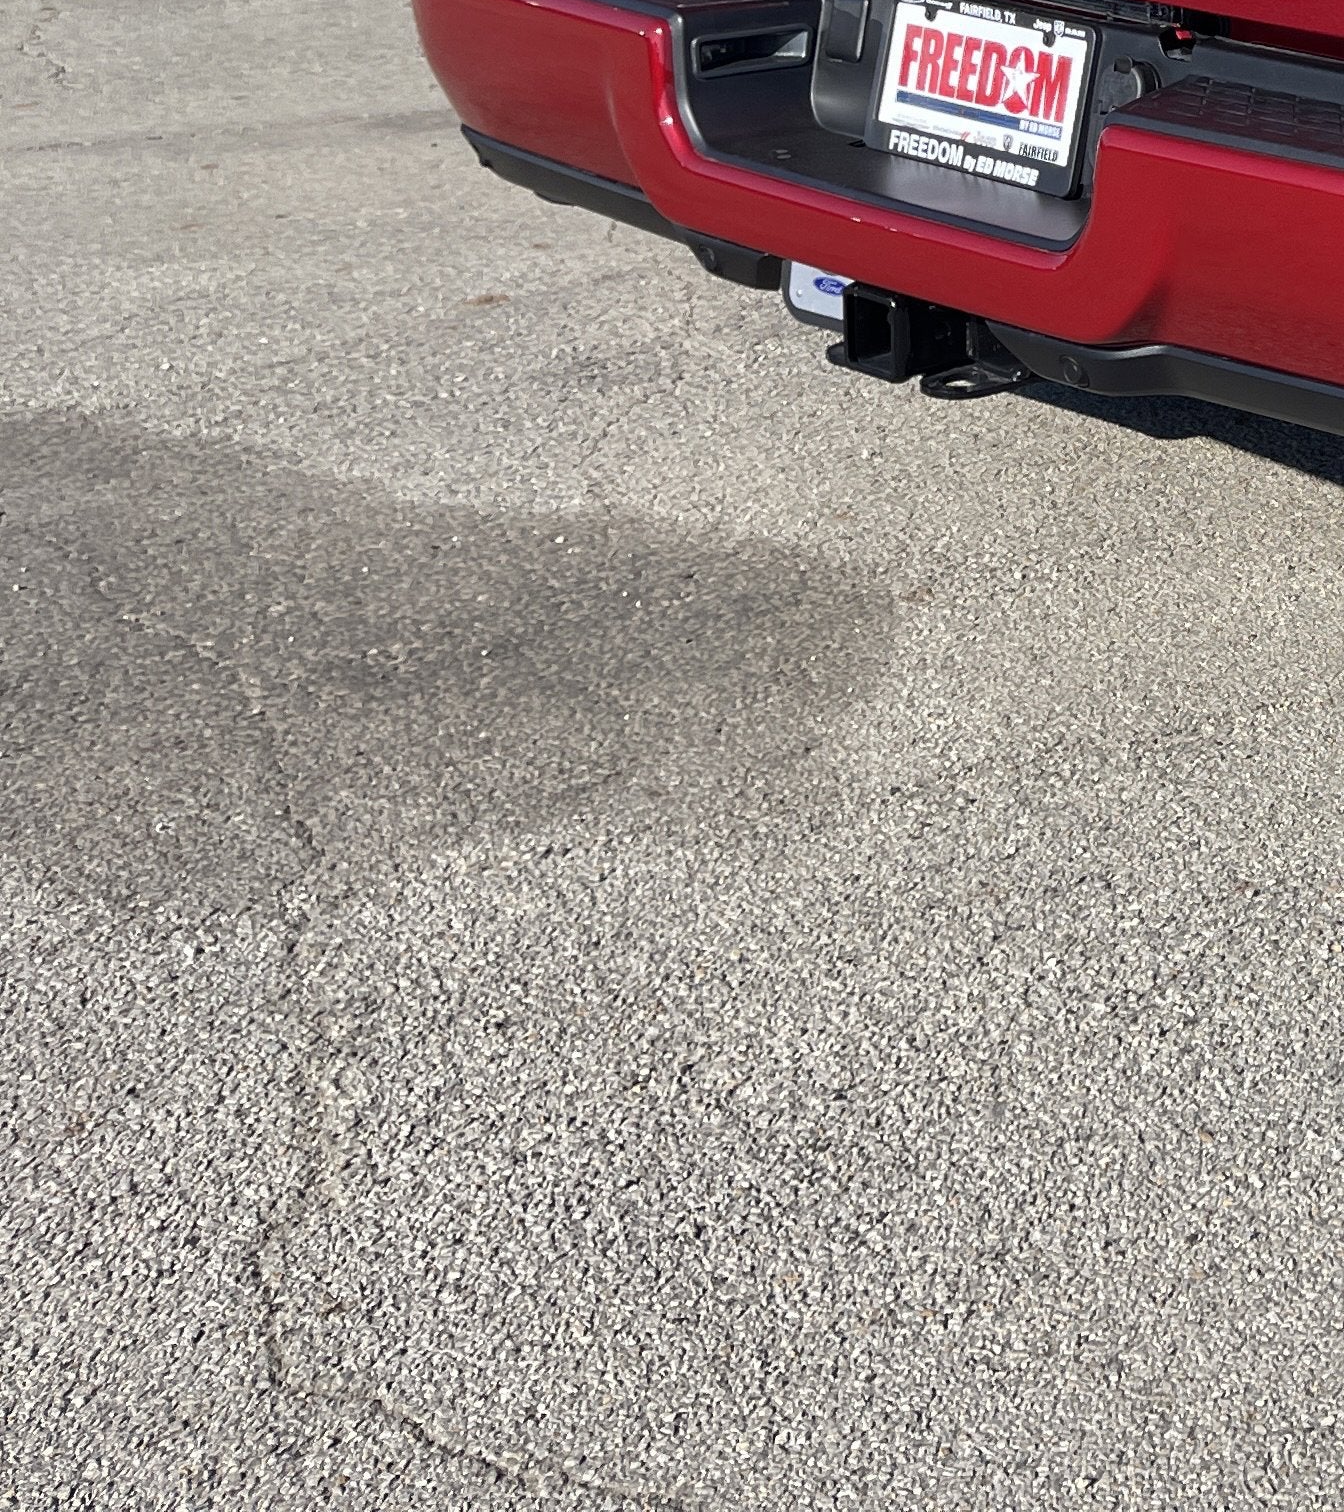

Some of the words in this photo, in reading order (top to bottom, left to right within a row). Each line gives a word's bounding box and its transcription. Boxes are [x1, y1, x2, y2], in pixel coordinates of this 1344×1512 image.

[1004, 9, 1016, 25] TX
[897, 23, 1072, 124] FREEDOM
[888, 129, 964, 167] FREEDOM
[976, 155, 994, 174] ED
[993, 159, 1039, 186] MORSE
[1018, 141, 1060, 162] FAIRFIELD
